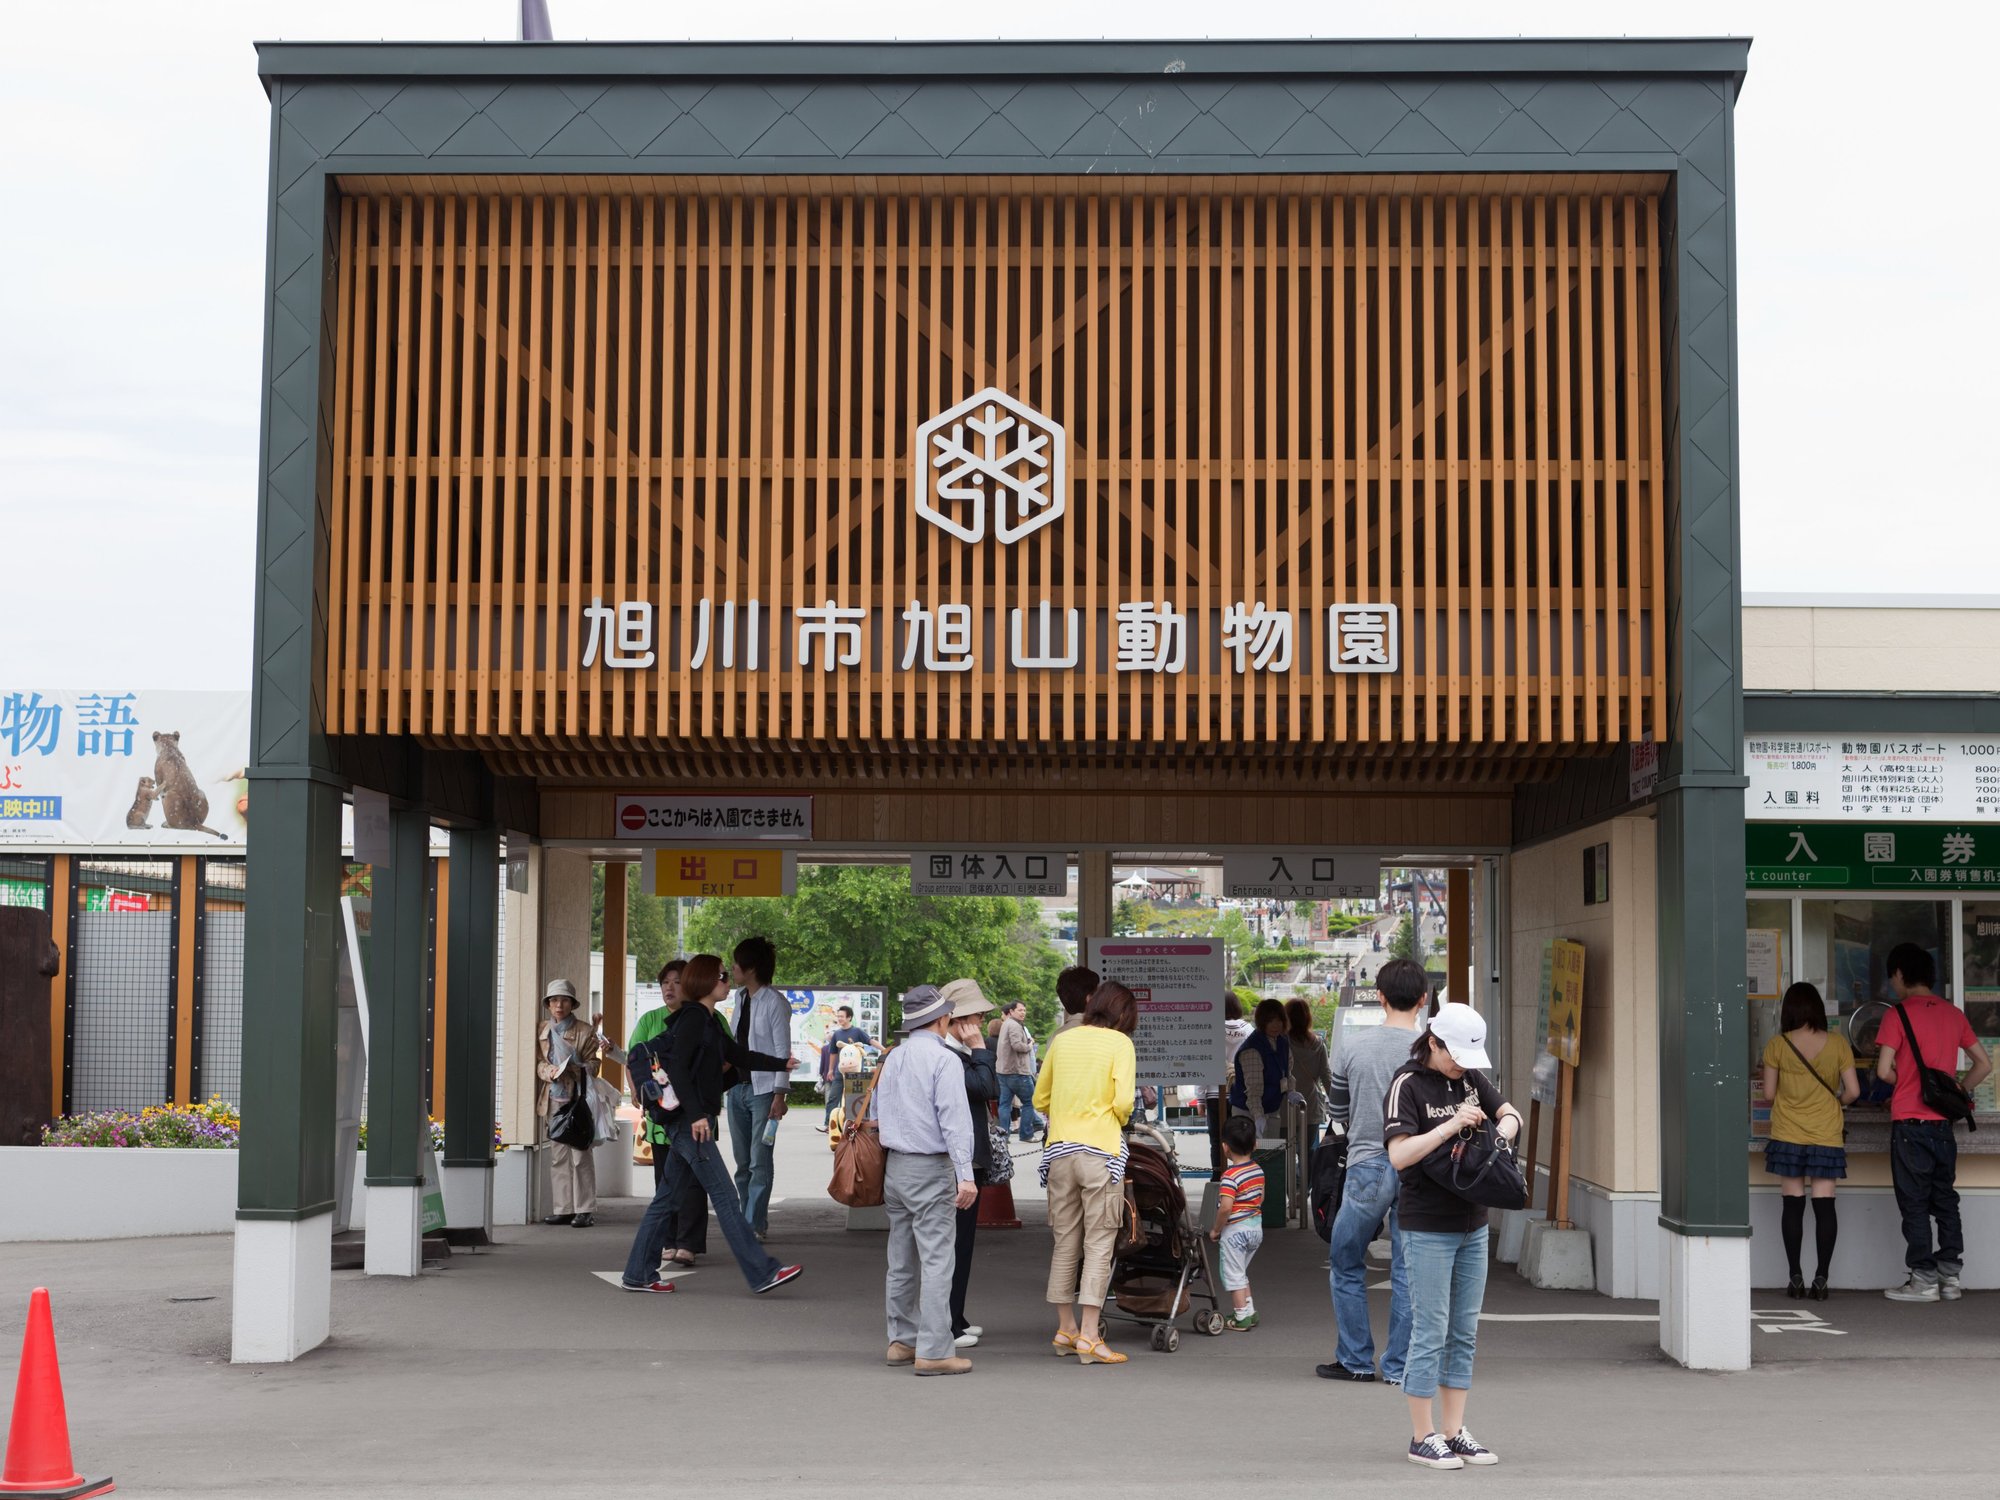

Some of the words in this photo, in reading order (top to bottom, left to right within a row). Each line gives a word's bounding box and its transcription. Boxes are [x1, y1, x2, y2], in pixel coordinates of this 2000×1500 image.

[582, 597, 1399, 674] 旭川市旭山動物園
[0, 692, 139, 757] 物語
[1841, 742, 1947, 755] 動物園パスポート
[1763, 790, 1820, 804] 入園料
[0, 799, 55, 819] 映中!!
[647, 807, 805, 828] ここからは入園できません
[1842, 805, 1932, 813] 中学生以下
[1785, 831, 1976, 864] 入園券
[680, 856, 758, 880] 出口
[929, 854, 1048, 879] 団体入口
[1269, 856, 1334, 881] 入口
[1762, 870, 1812, 881] counter
[702, 883, 735, 895] EXIT
[1232, 885, 1273, 896] Entrance
[1289, 886, 1314, 896] 入口
[1338, 886, 1363, 897] 입구
